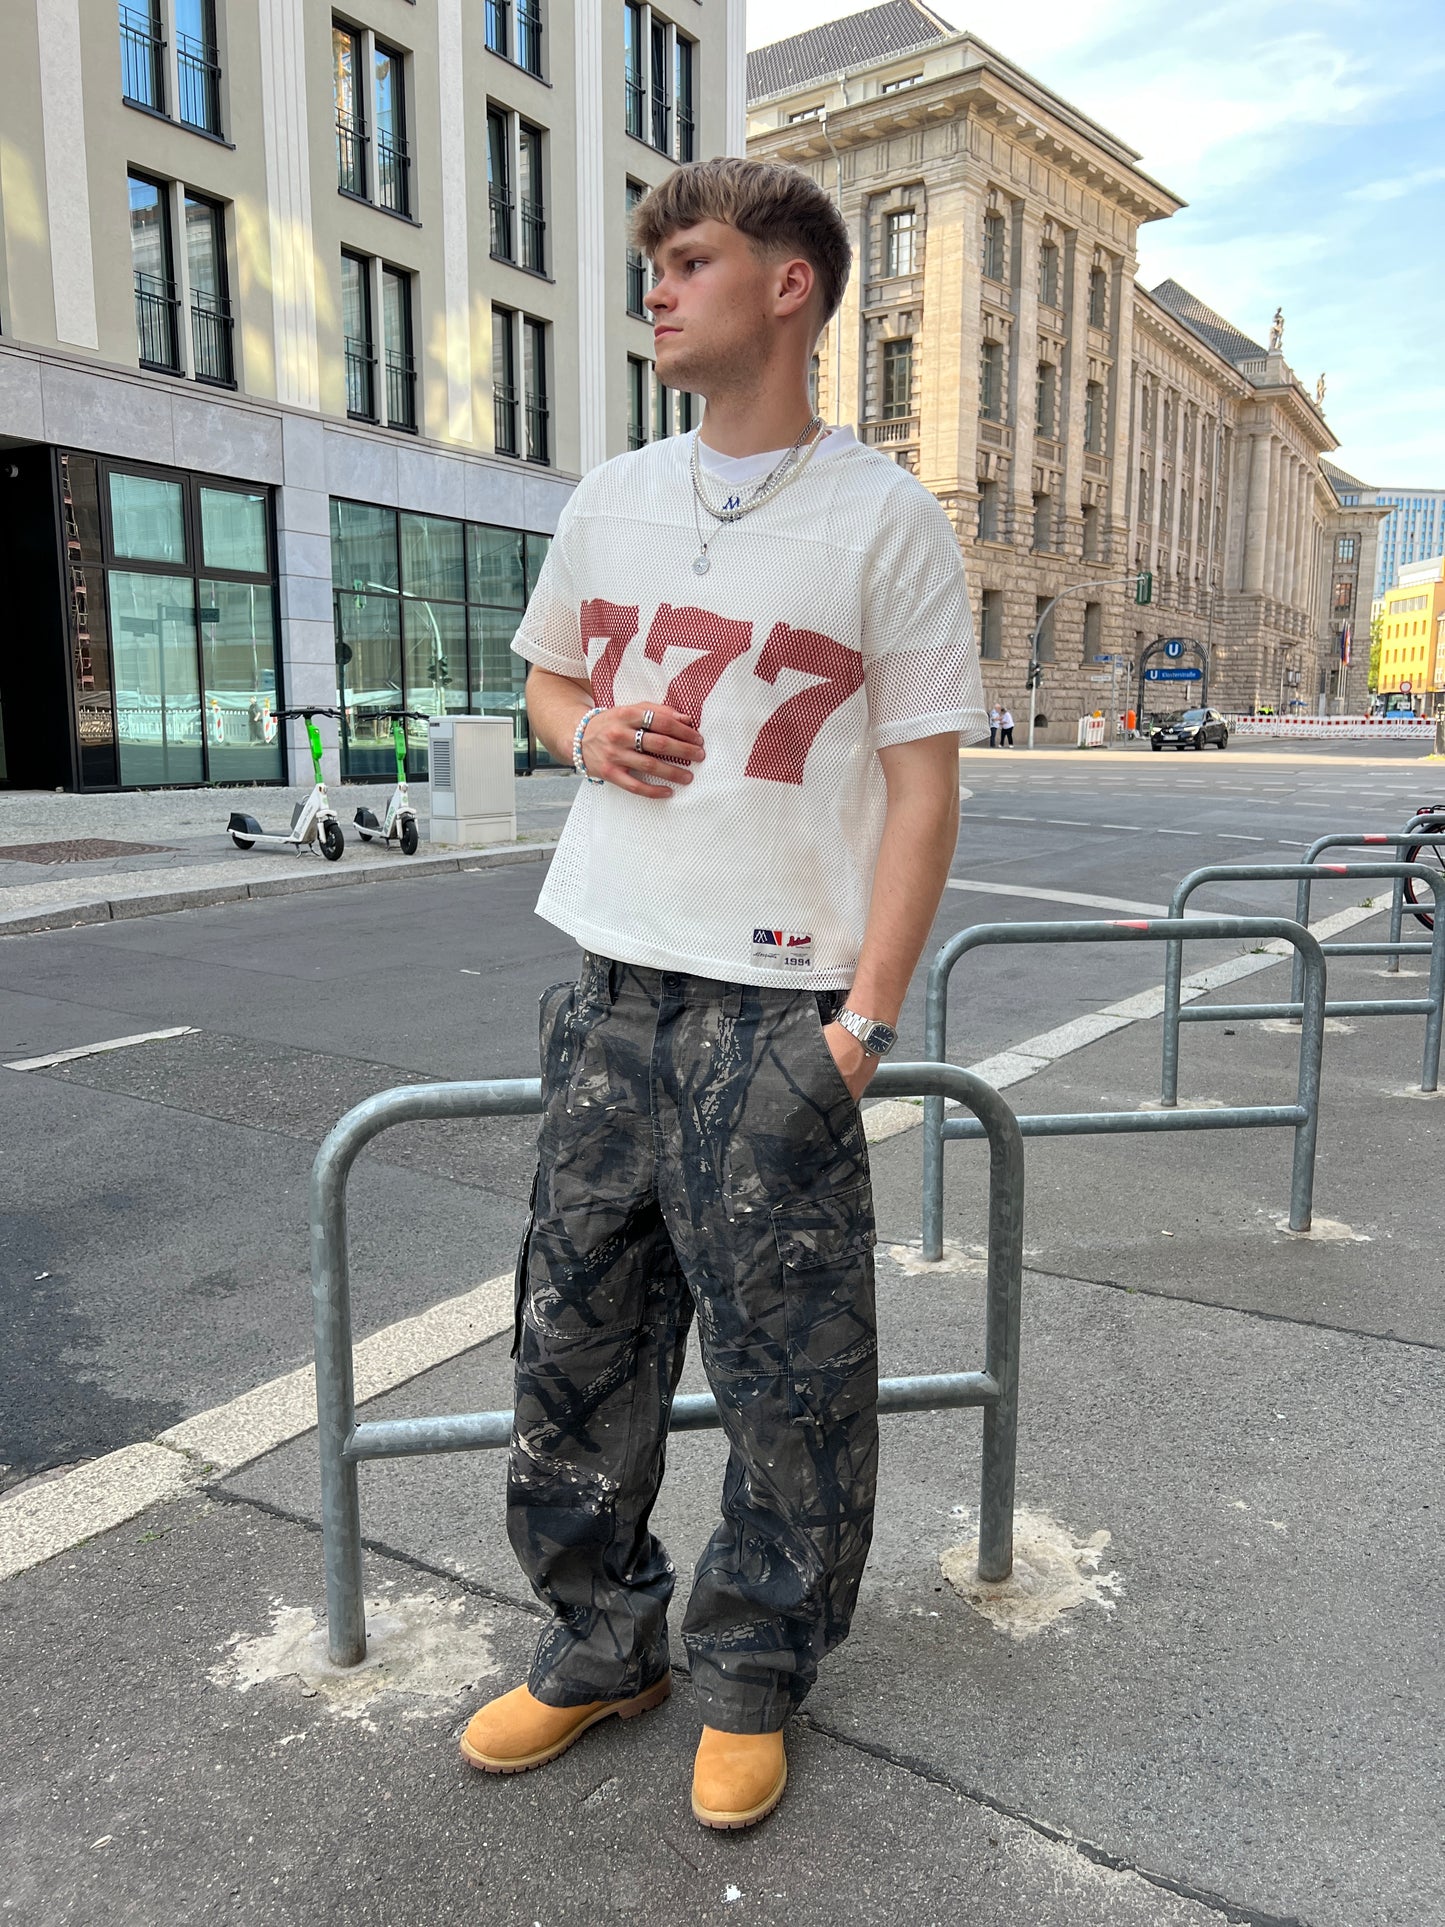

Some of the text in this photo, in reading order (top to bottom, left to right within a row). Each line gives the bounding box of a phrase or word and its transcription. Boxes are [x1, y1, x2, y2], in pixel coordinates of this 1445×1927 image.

[1168, 643, 1179, 656] U
[1150, 670, 1158, 679] U
[580, 597, 865, 786] 777
[784, 957, 811, 967] 1994
